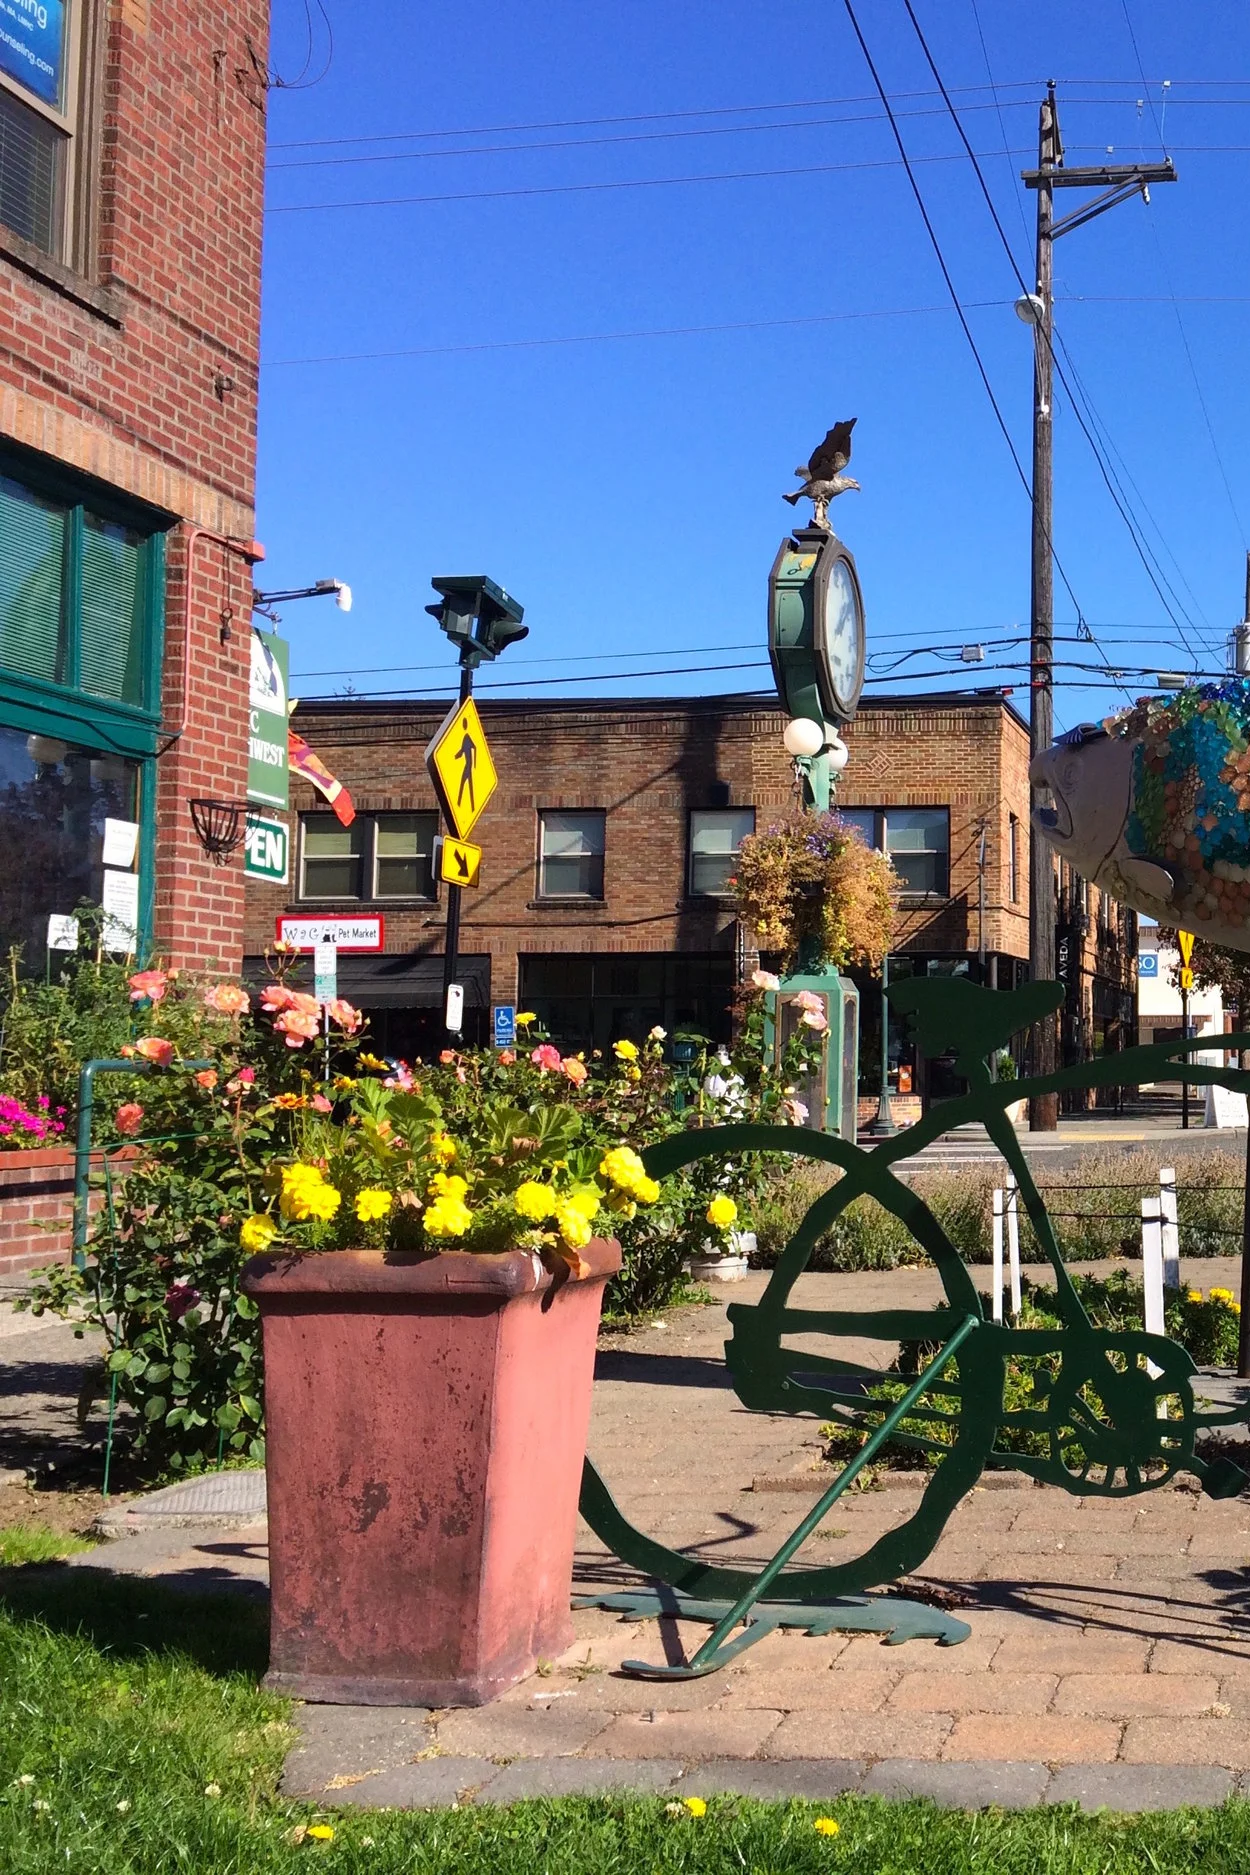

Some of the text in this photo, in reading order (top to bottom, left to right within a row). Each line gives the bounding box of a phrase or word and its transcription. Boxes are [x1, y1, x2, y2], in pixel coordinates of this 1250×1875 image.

[338, 928, 350, 939] Pet
[352, 927, 377, 938] Market
[1059, 936, 1068, 979] AVEDA
